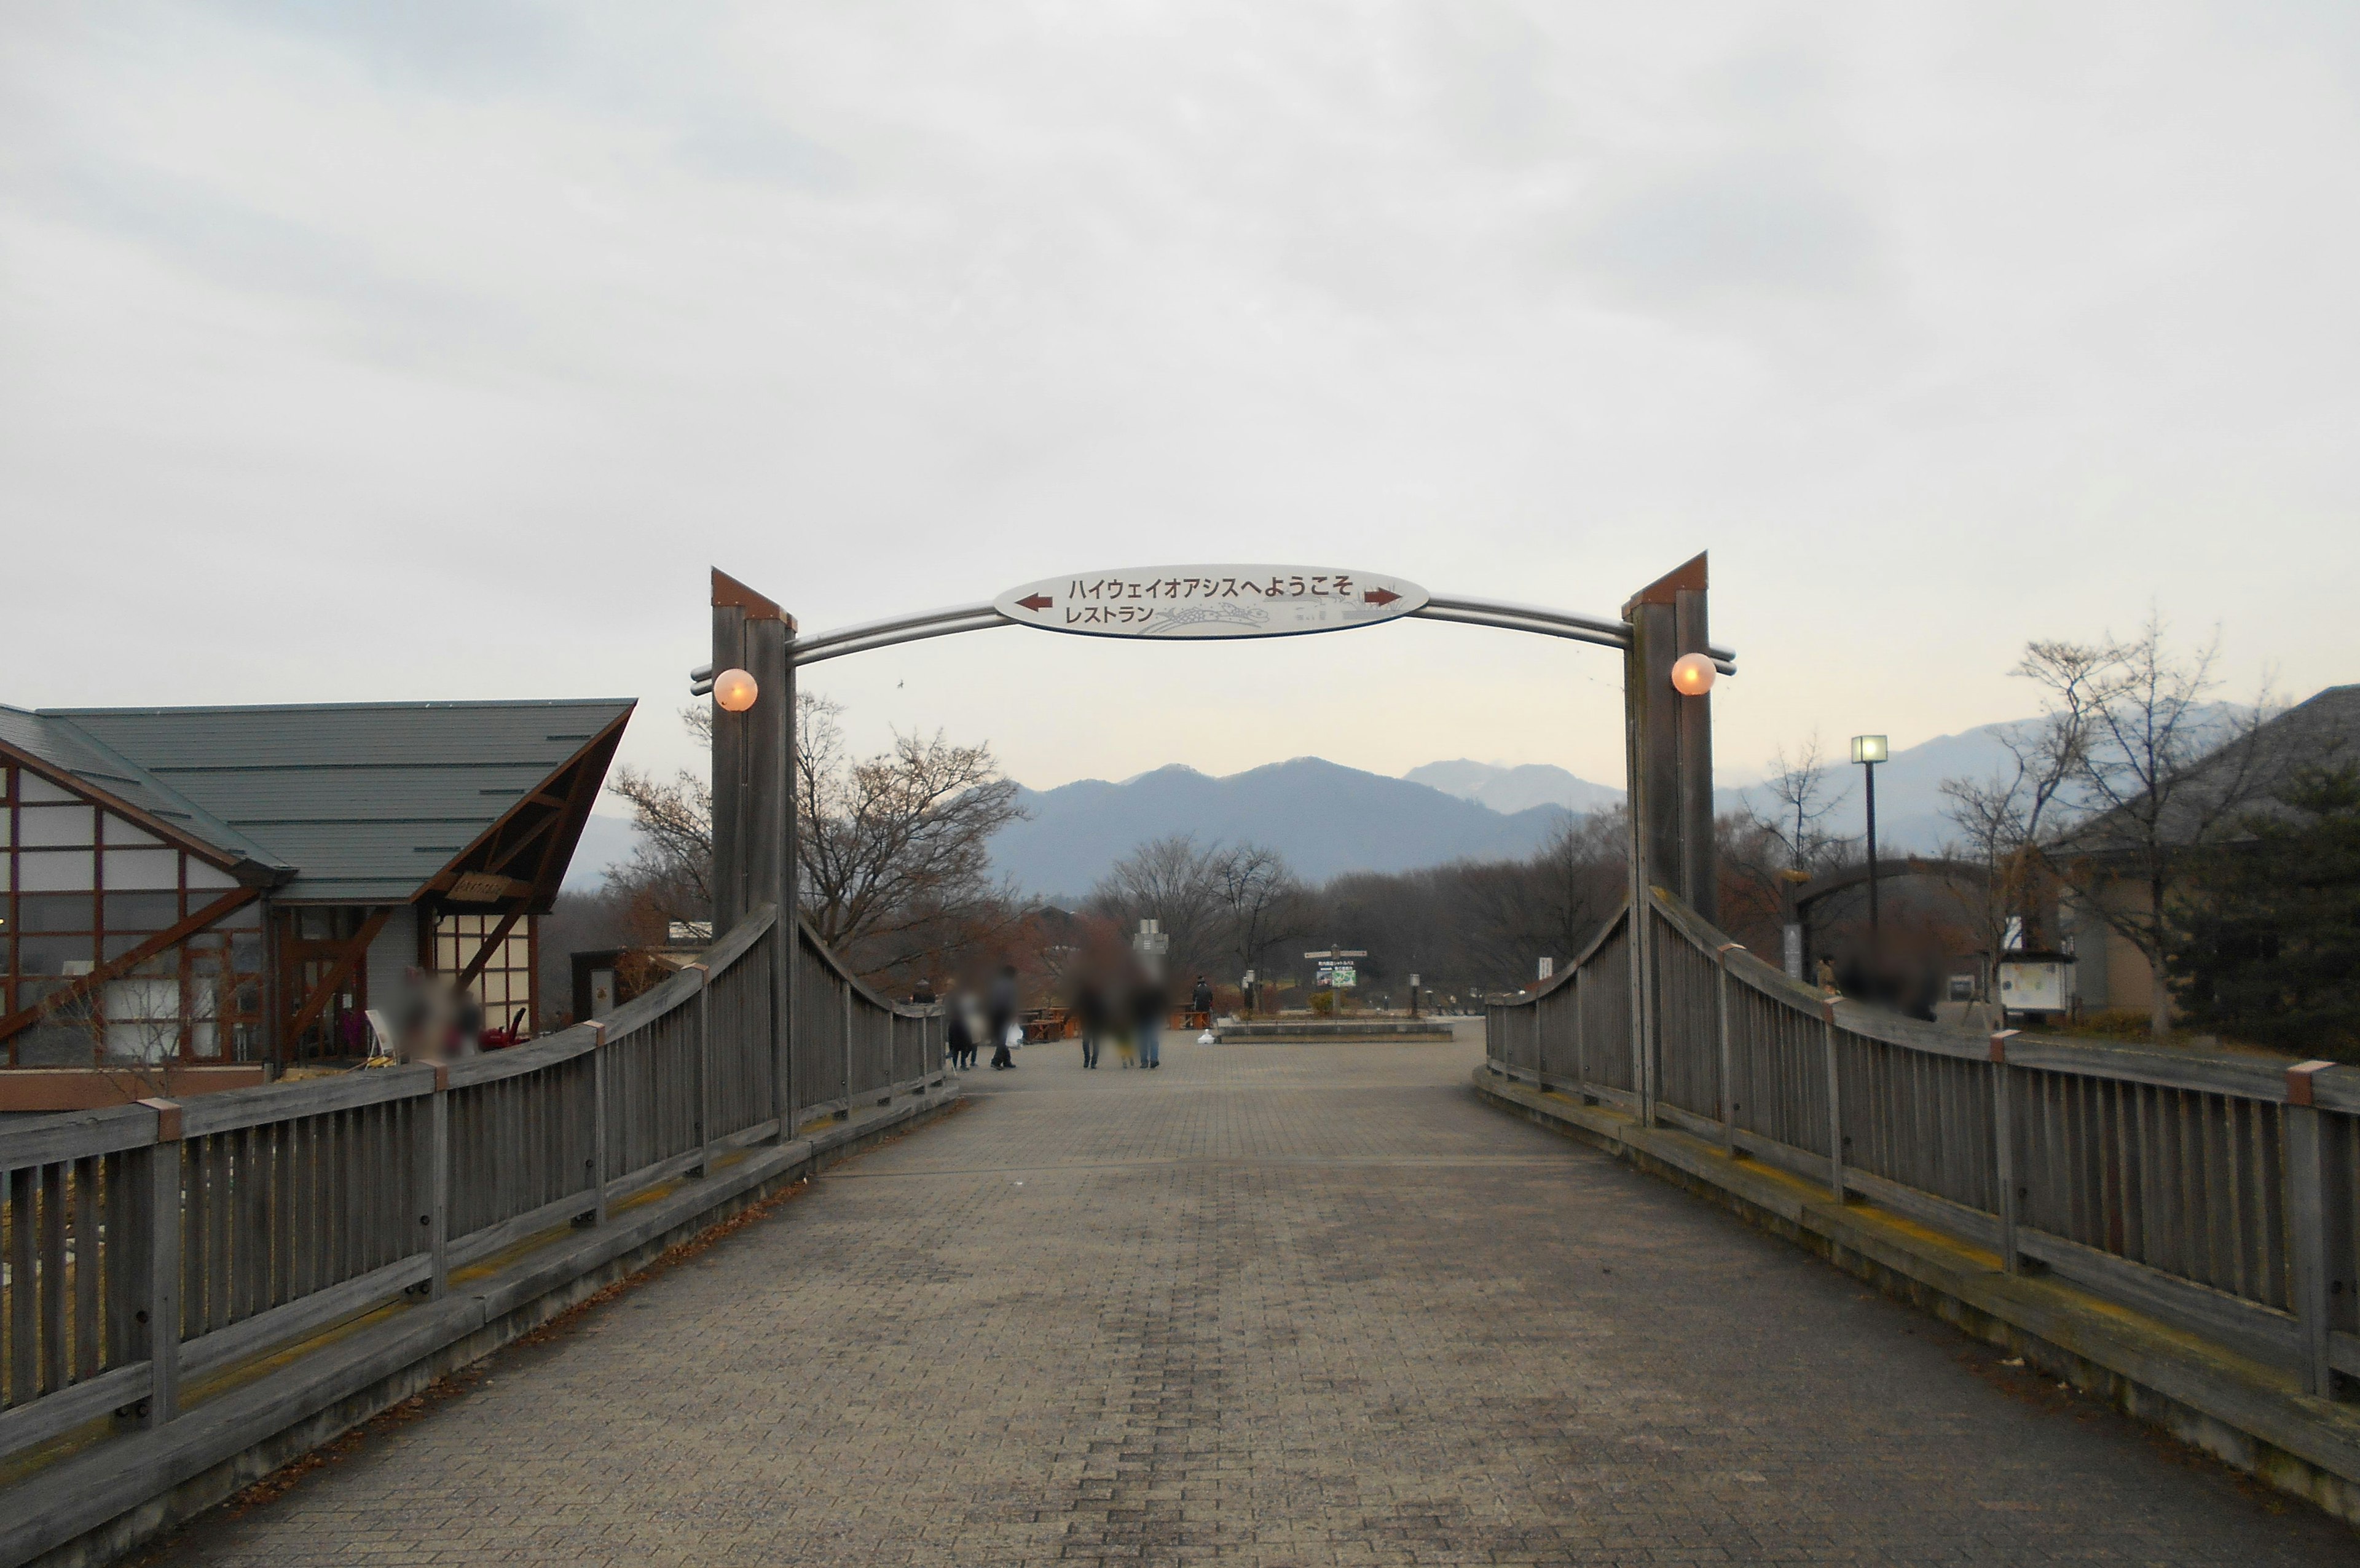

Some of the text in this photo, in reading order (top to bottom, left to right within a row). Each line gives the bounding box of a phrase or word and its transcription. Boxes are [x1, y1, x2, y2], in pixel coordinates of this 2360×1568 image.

[1069, 576, 1353, 599] ハイウェイオアシスへようこそ
[1066, 606, 1154, 623] レストラン
